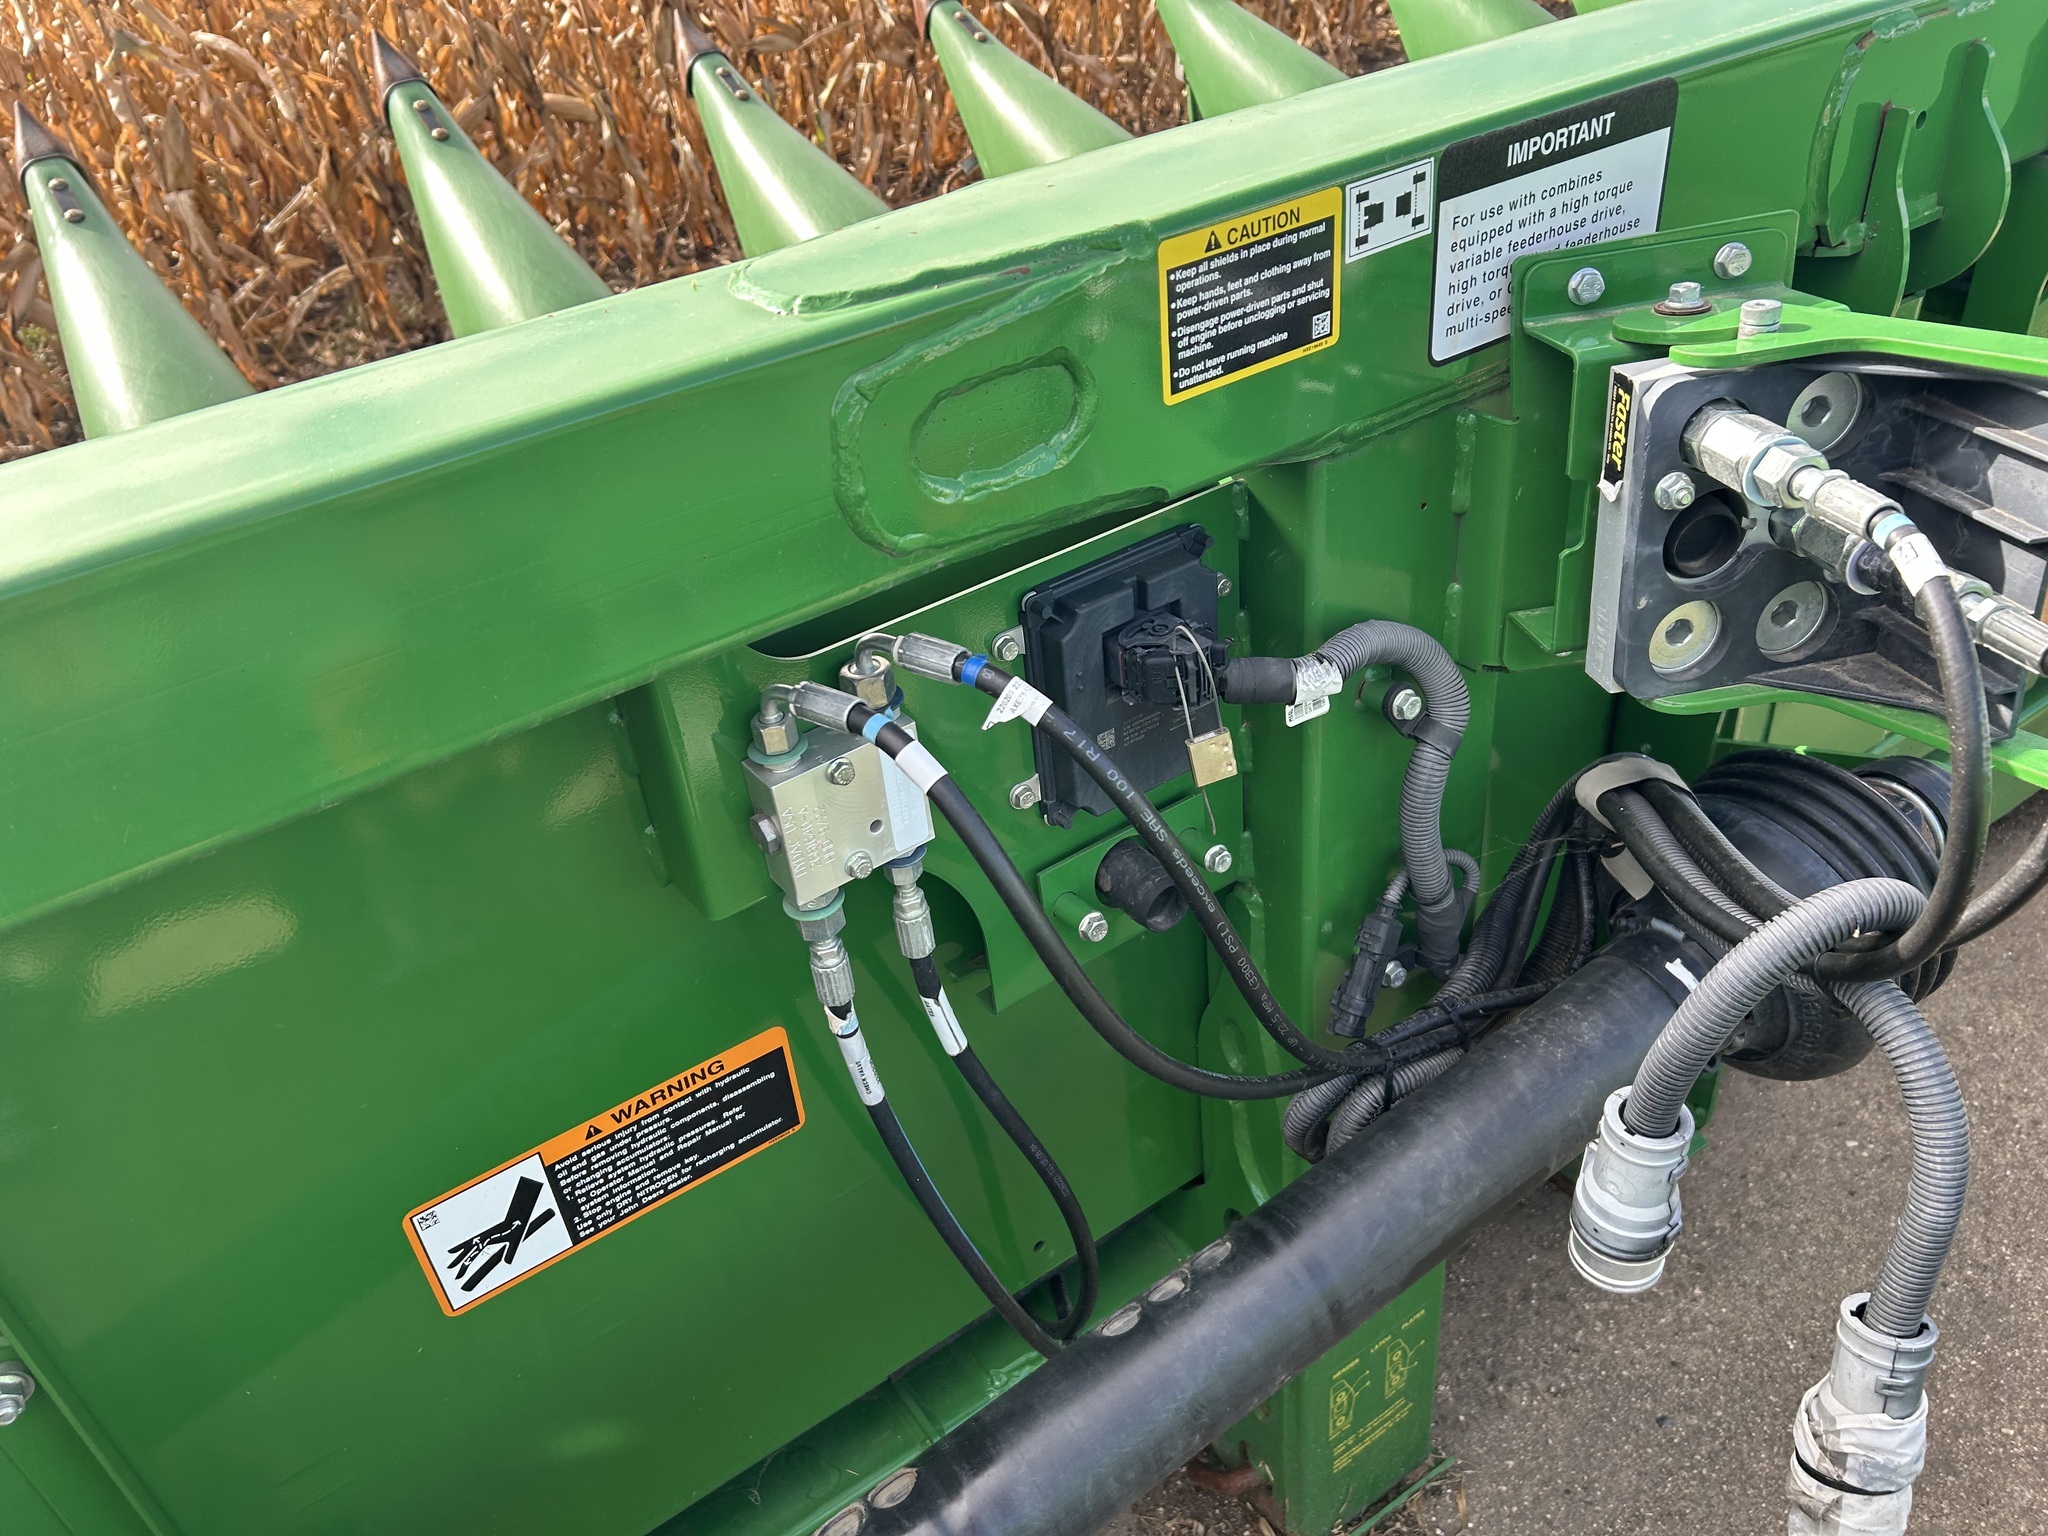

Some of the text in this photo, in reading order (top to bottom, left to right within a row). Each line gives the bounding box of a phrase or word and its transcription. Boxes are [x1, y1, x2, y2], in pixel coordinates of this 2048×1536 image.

[1507, 112, 1615, 167] IMPORTANT
[1227, 206, 1300, 245] CAUTION
[1450, 218, 1513, 253] equipped
[1518, 209, 1545, 230] with
[1549, 207, 1557, 219] a
[1561, 193, 1589, 215] high
[1593, 180, 1633, 203] torque
[1452, 170, 1603, 231] For use with combines
[1175, 221, 1326, 281] Keep all shields in place during normal
[1449, 246, 1503, 274] variable
[1507, 217, 1587, 254] feederhouse
[1591, 204, 1625, 224] drive,
[1175, 271, 1222, 294] operations.
[1176, 249, 1331, 309] Keep hands, feet and clothing away from
[1176, 288, 1253, 323] power-driven parts.
[1177, 277, 1324, 338] Disengage power-driven parts and shut
[1447, 296, 1484, 316] drive,
[1489, 287, 1502, 301] or
[1448, 275, 1477, 296] high
[1177, 287, 1330, 349] off engine before unclogging or servicing
[1446, 301, 1512, 337] multi-spee
[1178, 341, 1214, 360] machine.
[1178, 331, 1288, 378] Do not leave running machine
[1178, 364, 1224, 389] unattended.
[1611, 388, 1631, 472] Faster
[1062, 729, 1101, 763] R17
[1106, 768, 1135, 801] 100
[782, 806, 807, 879] HYDAC USA
[1140, 809, 1169, 843] SAE
[1172, 848, 1216, 913] exceeds
[1216, 921, 1238, 954] PSI)
[1237, 957, 1260, 990] (3300
[610, 1059, 726, 1125] WARNING
[855, 1059, 871, 1095] CHECK VALVE
[554, 1067, 750, 1172] Avoid serious injury from contact with hydraulic
[556, 1116, 673, 1179] oil and gas under pressure.
[559, 1071, 775, 1187] Before removing hydraulic components, disassembling
[562, 1134, 671, 1194] or changing accumulators:
[574, 1178, 604, 1197] Relieve
[607, 1161, 636, 1180] system
[638, 1140, 675, 1163] hydraulic
[678, 1119, 718, 1143] pressures.
[722, 1104, 743, 1119] Refer
[576, 1219, 593, 1231] Use
[595, 1208, 613, 1220] only
[616, 1195, 633, 1210] DRY
[636, 1172, 678, 1199] NITROGEN
[680, 1165, 692, 1175] for
[695, 1142, 735, 1167] recharging
[738, 1117, 783, 1144] accumulator.
[577, 1111, 746, 1204] to Operator Manual and Repair Manual for
[573, 1153, 700, 1224] 2. Stop engine and remove key.
[578, 1174, 693, 1238] See your John Deere dealer.
[580, 1167, 659, 1212] system information.
